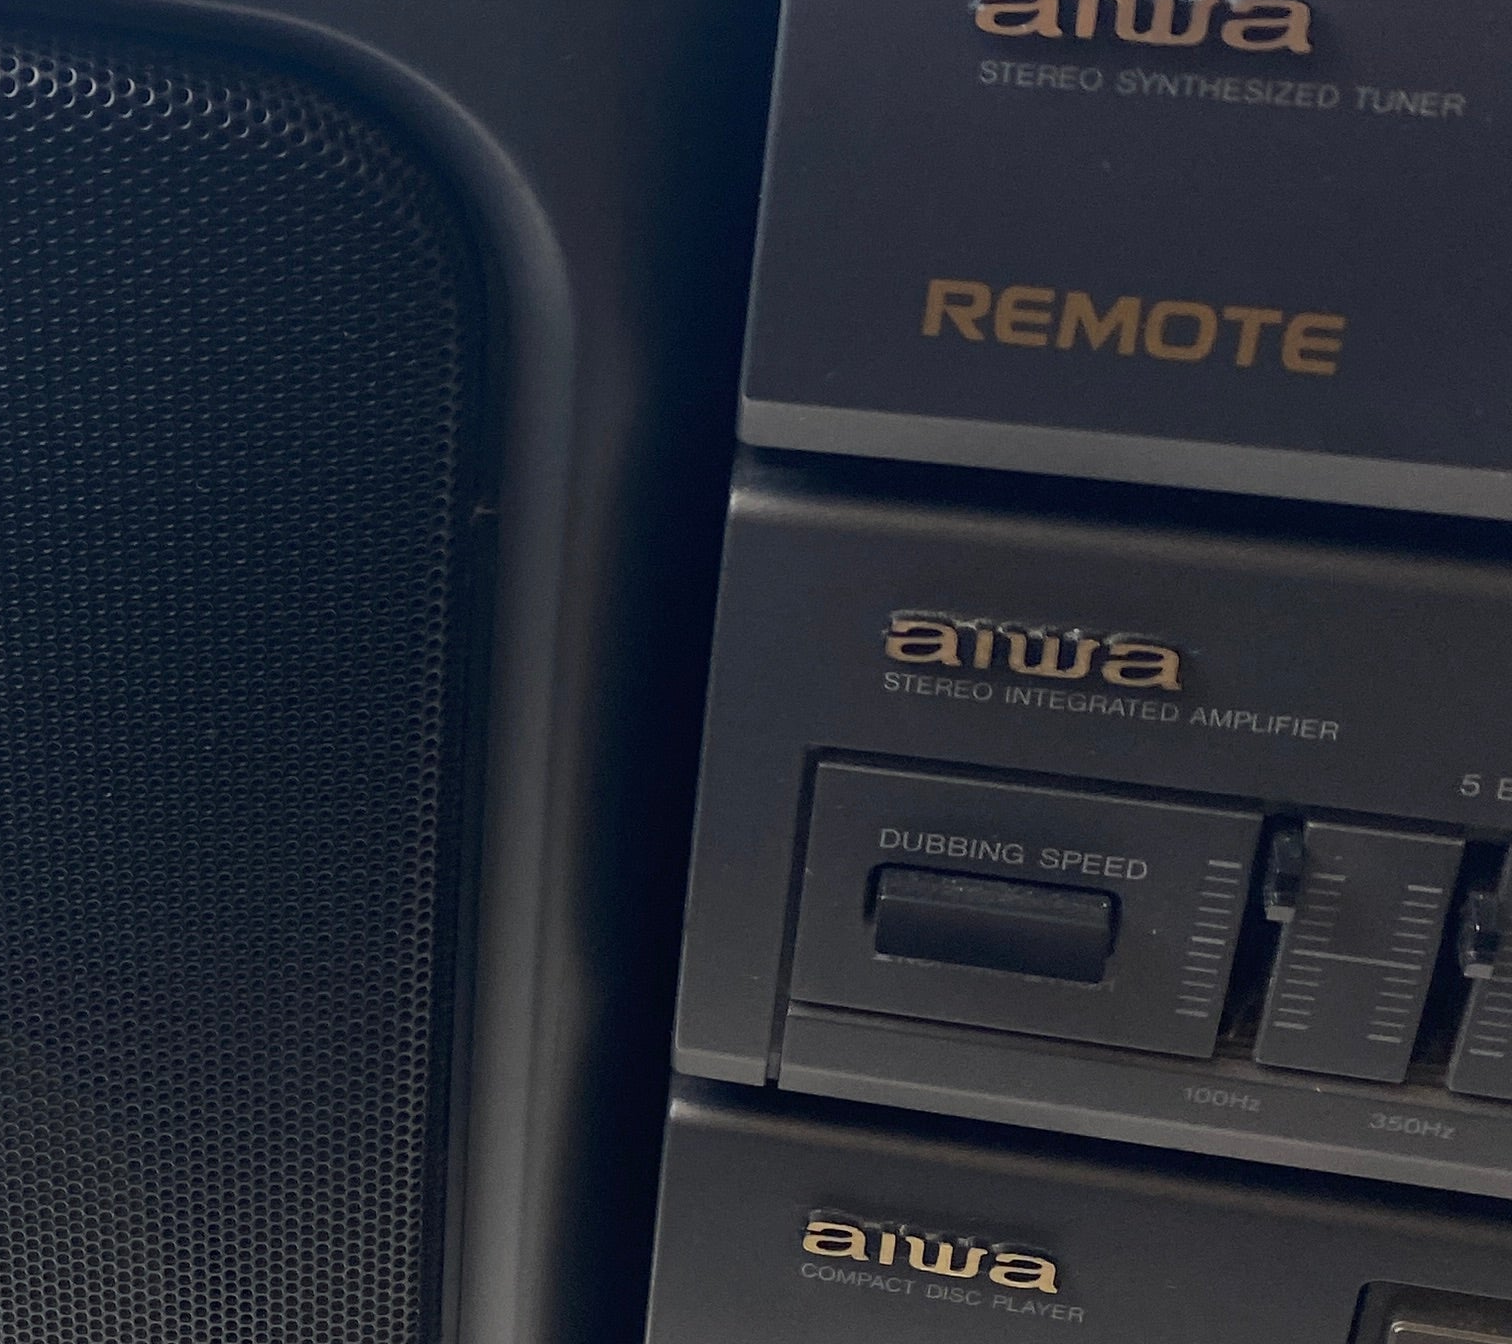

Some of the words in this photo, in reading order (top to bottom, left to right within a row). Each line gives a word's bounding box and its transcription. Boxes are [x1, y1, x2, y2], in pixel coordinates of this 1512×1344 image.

[979, 59, 1103, 91] STEREO
[1116, 67, 1340, 110] SYNTHESIZED
[1354, 86, 1467, 119] TUNER
[922, 278, 1348, 376] REMOTE
[884, 614, 1182, 691] aiwa
[883, 671, 992, 701] STEREO
[1005, 686, 1180, 722] INTEGRATED
[1190, 706, 1340, 742] AMPLIFIER
[1460, 774, 1481, 798] 5
[879, 828, 1024, 865] DUBBING
[1039, 846, 1148, 881] SPEED
[1183, 1086, 1261, 1112] 100Hz
[1368, 1112, 1457, 1140] 350Hz
[802, 1217, 1058, 1294] aiwa
[801, 1262, 916, 1294] COMPACT
[926, 1283, 982, 1306] DISC
[992, 1294, 1085, 1323] PLAYER
